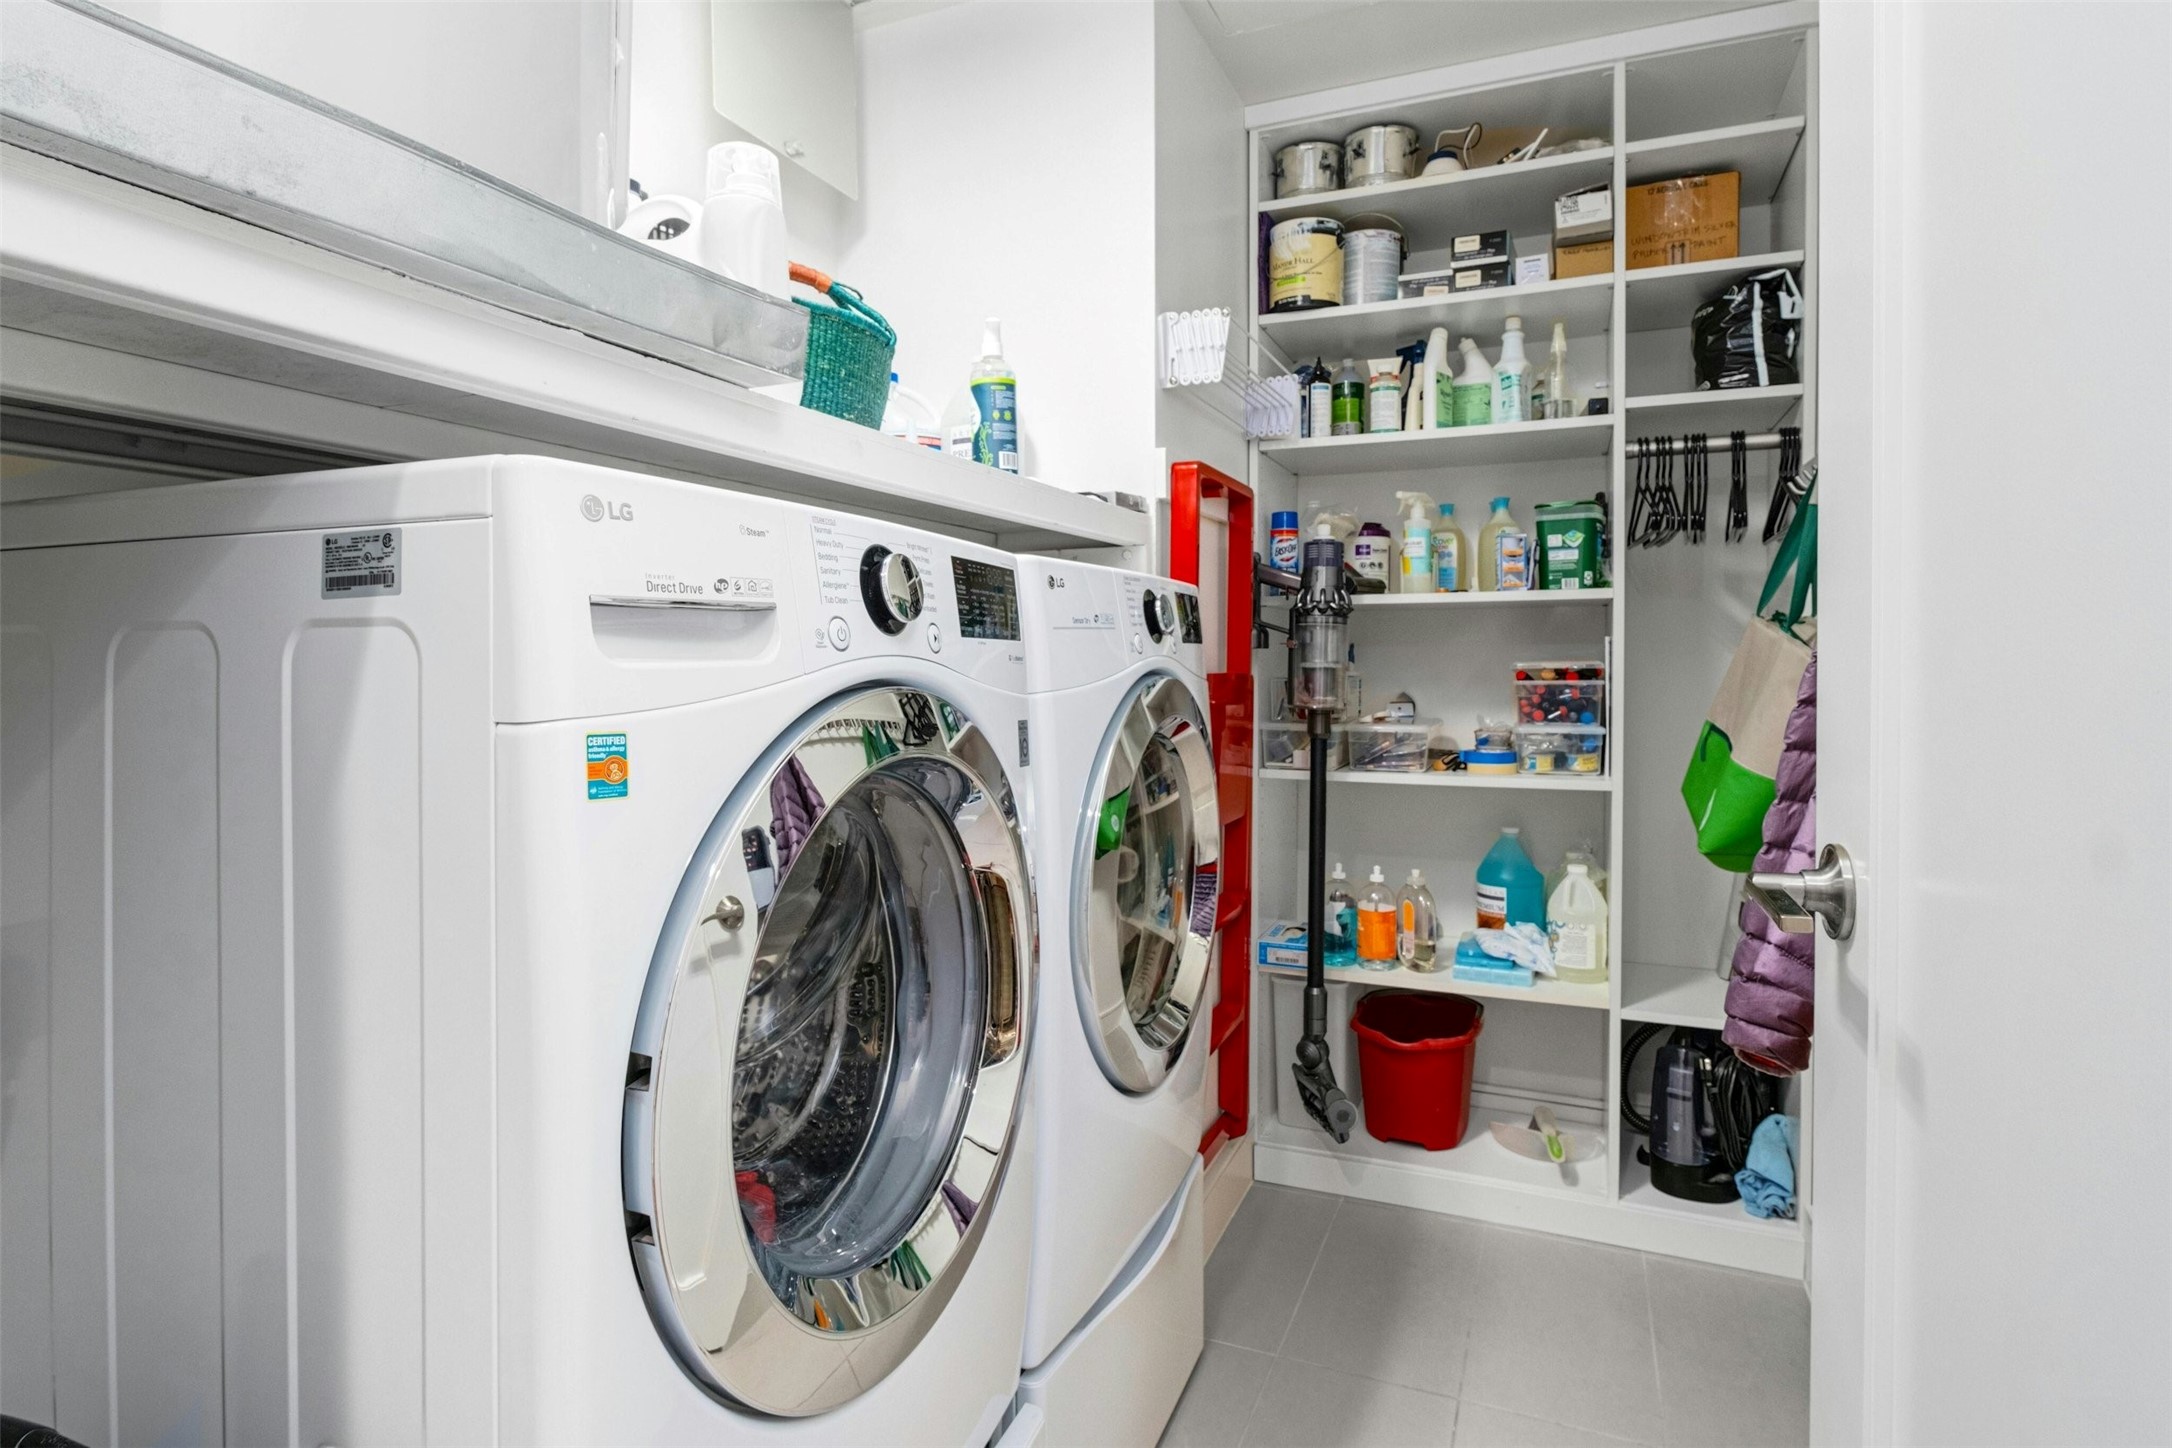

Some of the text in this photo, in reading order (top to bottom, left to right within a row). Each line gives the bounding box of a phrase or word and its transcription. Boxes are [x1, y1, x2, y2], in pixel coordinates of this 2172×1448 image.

[607, 501, 634, 521] LG
[817, 552, 839, 563] Bedding
[820, 566, 841, 576] Sanitary
[646, 580, 704, 594] Direct Drive
[825, 596, 834, 604] Tub
[588, 736, 626, 746] CERTIFIED
